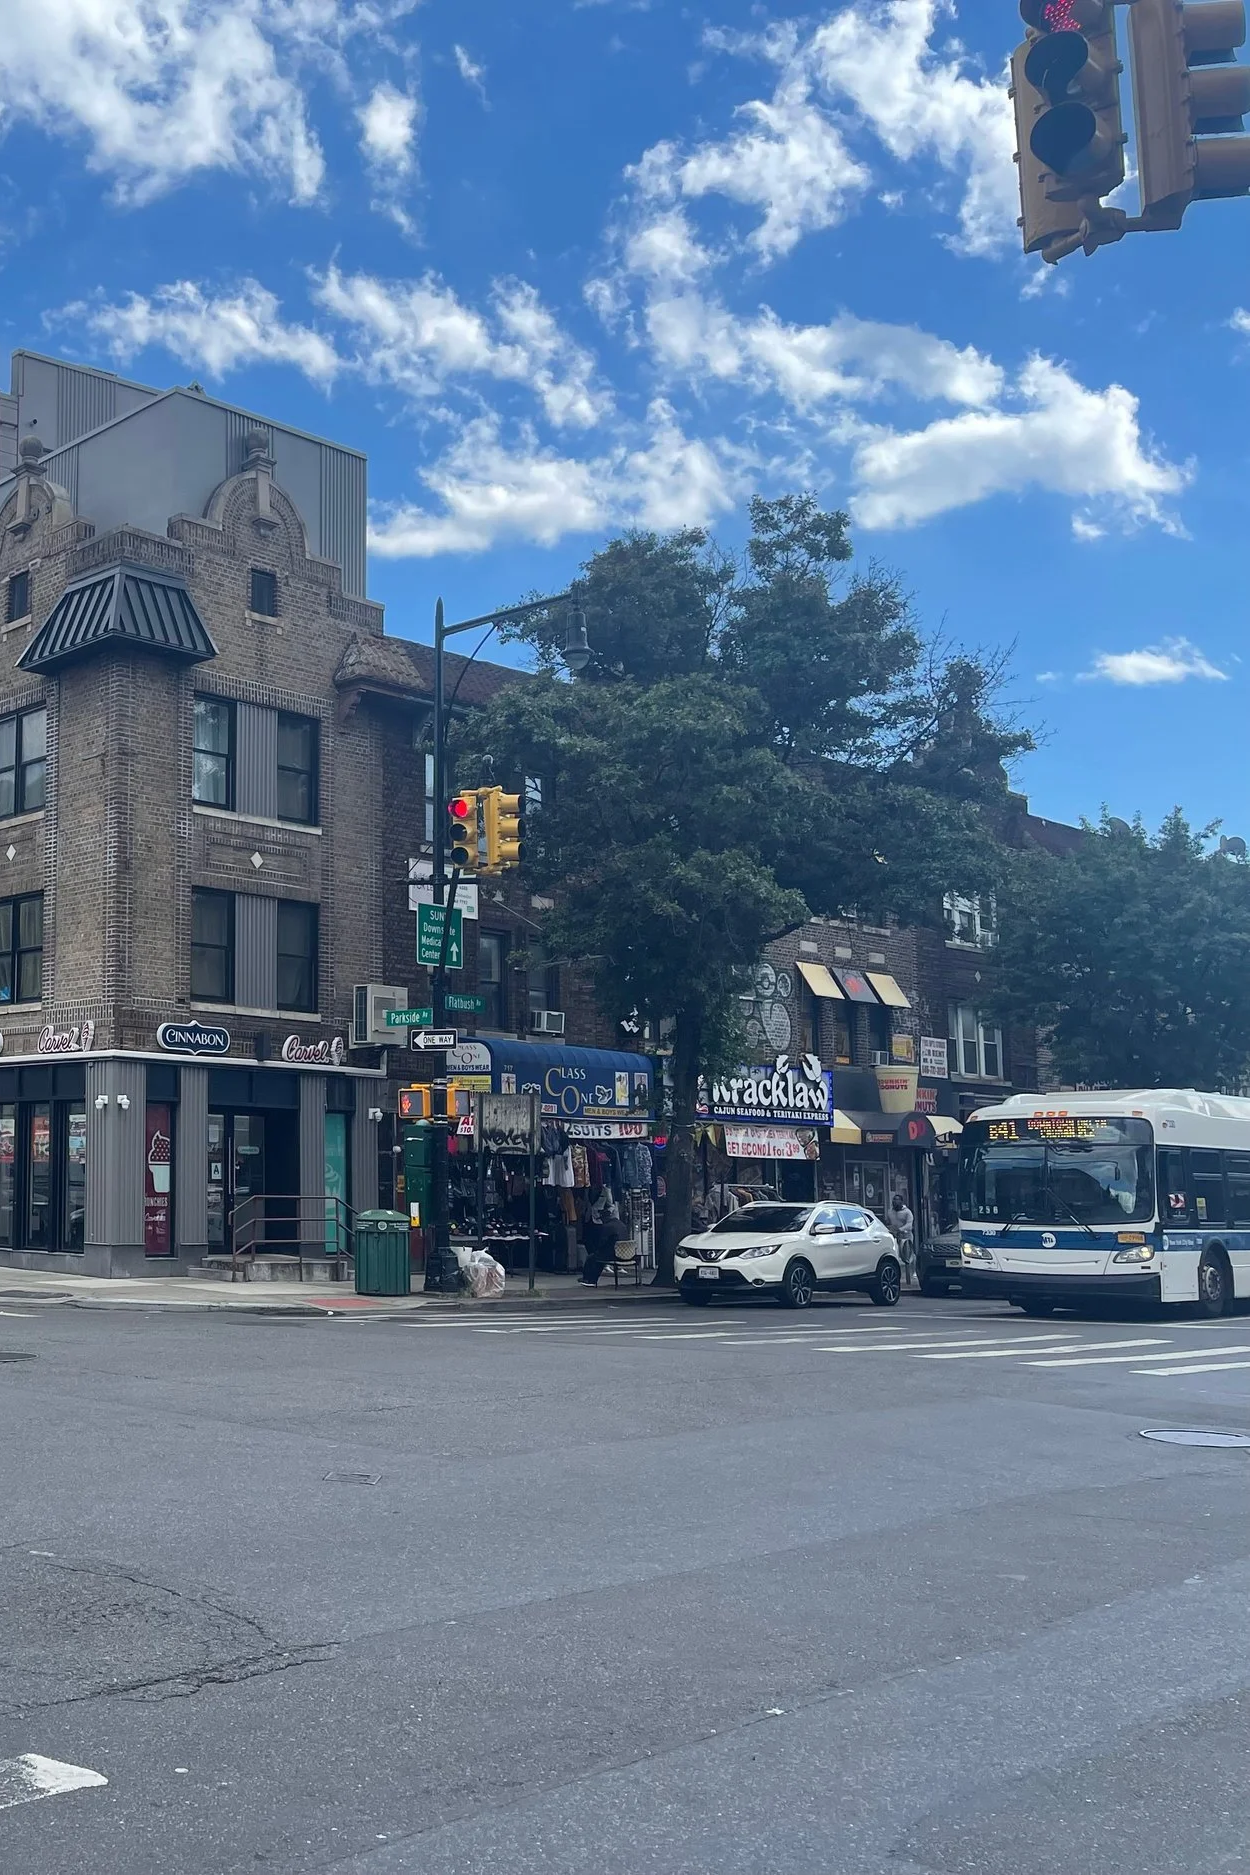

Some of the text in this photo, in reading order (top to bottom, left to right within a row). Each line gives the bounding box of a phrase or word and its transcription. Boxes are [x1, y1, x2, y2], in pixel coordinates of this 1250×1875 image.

[429, 910, 446, 922] SUN
[423, 922, 456, 936] Downste
[421, 935, 442, 947] Medica
[448, 996, 475, 1010] Flatbush
[390, 1012, 420, 1024] Parkside
[38, 1026, 74, 1052] Carvel
[165, 1029, 225, 1046] CINNABON
[423, 1035, 452, 1044] ONE WAY
[286, 1036, 328, 1062] Carvel
[712, 1068, 829, 1111] Kracklaw
[713, 1106, 829, 1121] CAJUN SEAFOOD & TERIYAKI EXPRESS
